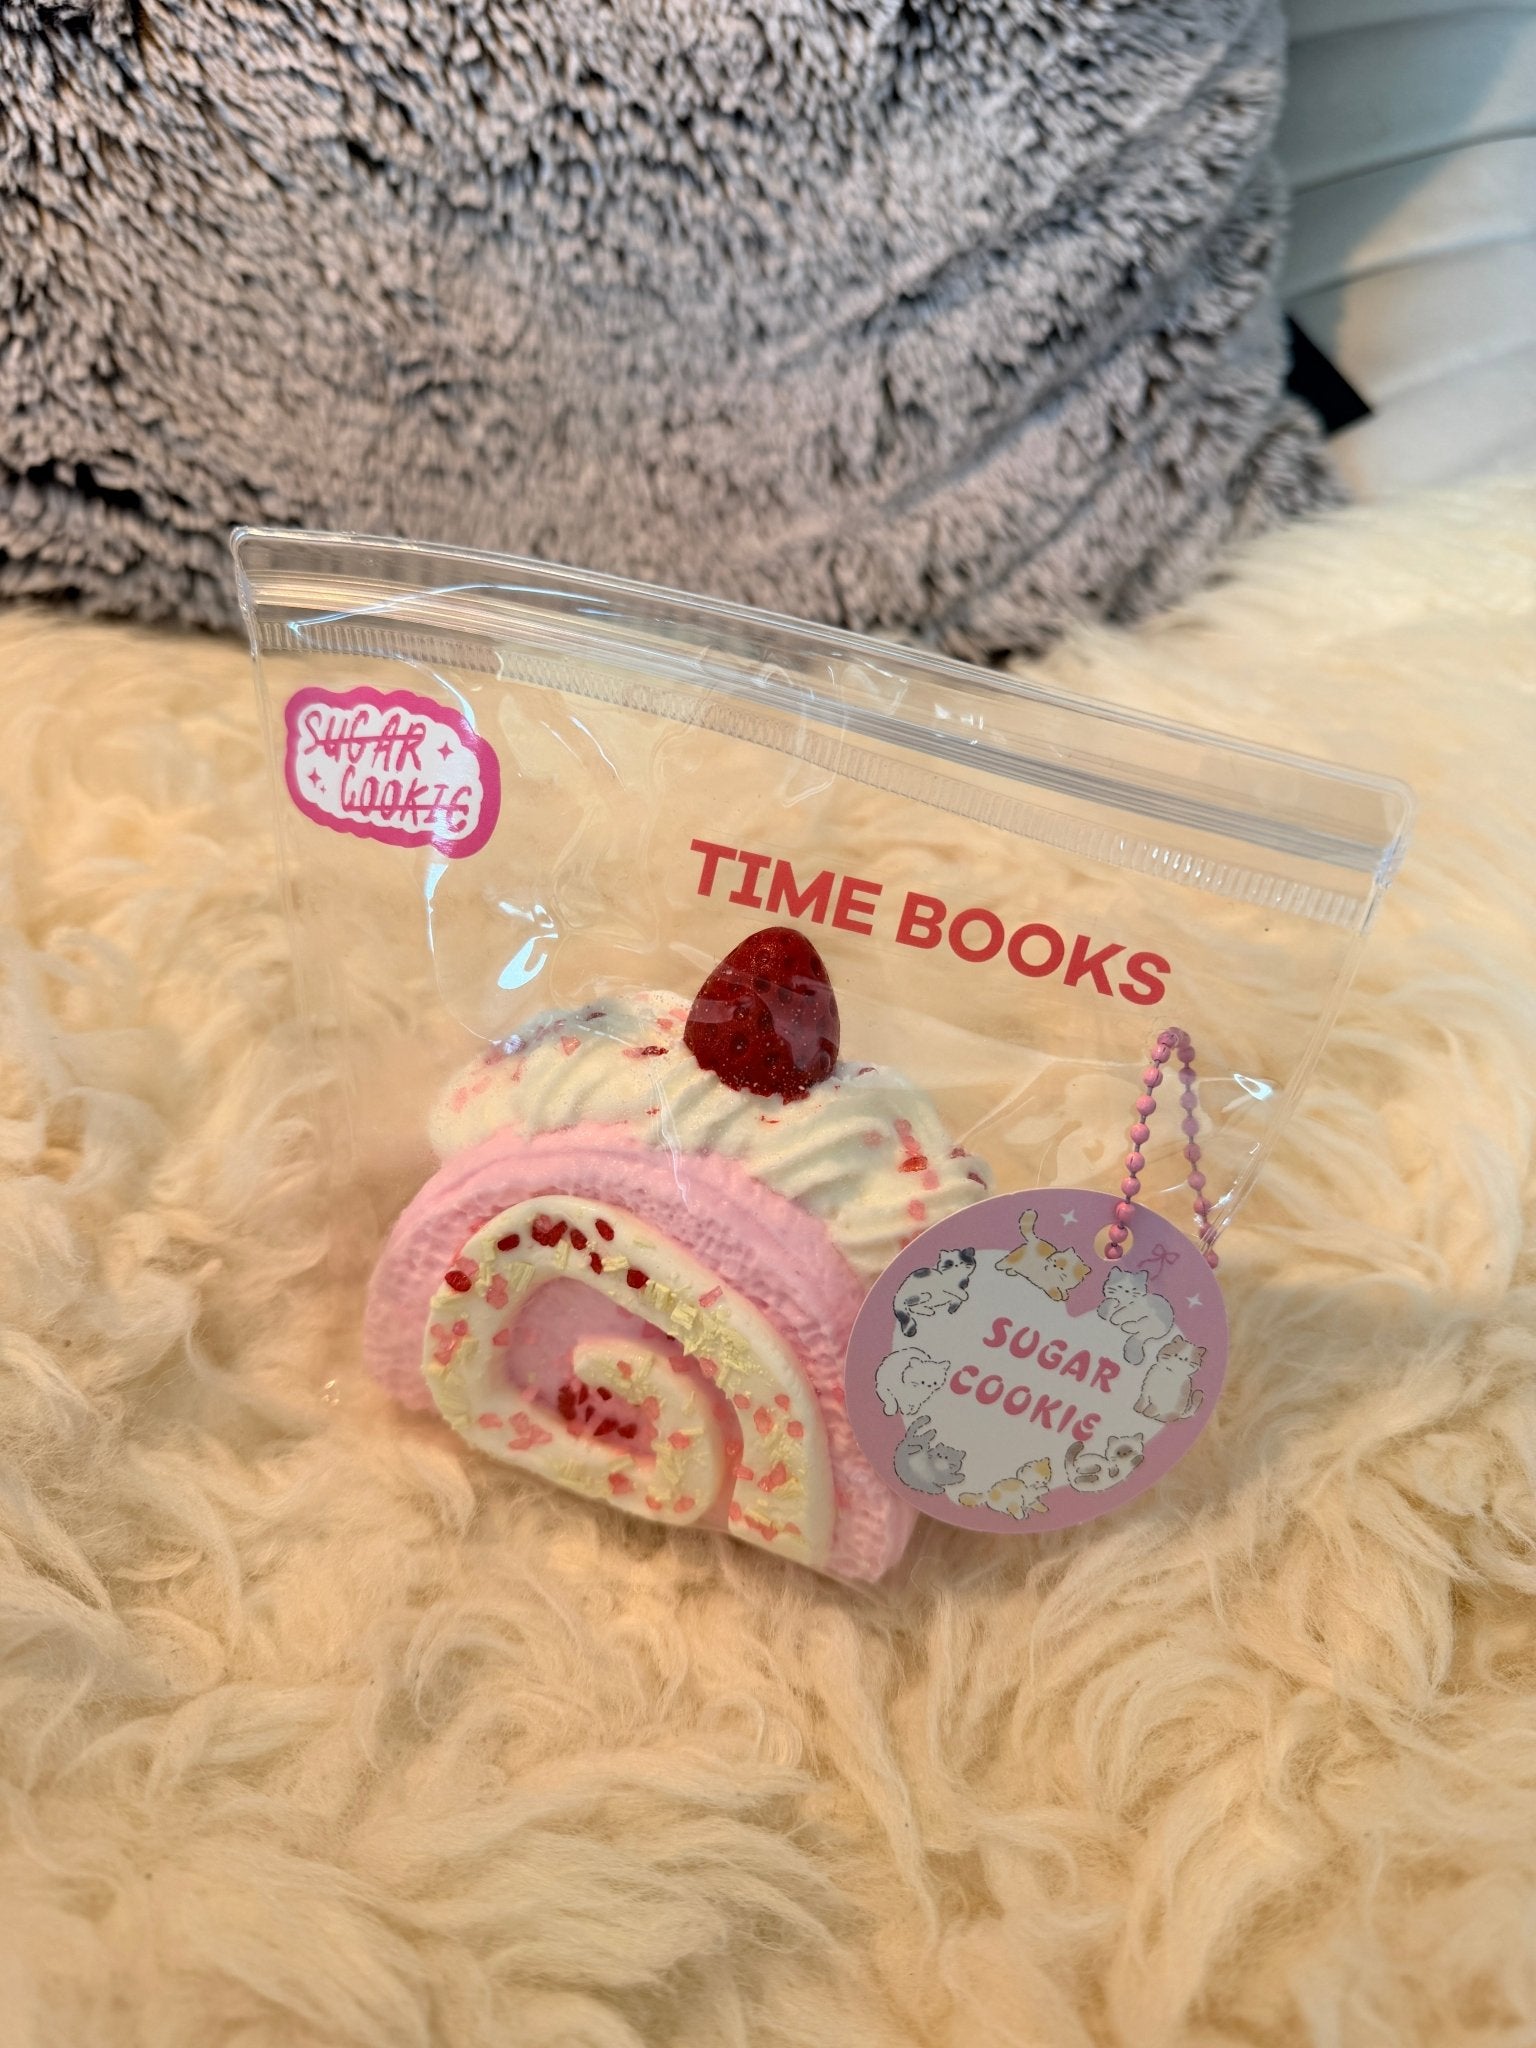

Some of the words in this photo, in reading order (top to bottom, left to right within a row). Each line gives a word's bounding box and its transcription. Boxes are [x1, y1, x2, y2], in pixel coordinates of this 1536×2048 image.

[304, 710, 427, 772] SUGAR
[690, 838, 883, 936] TIME
[895, 891, 1172, 1006] BOOKS
[982, 1316, 1121, 1393] SUGAR
[950, 1365, 1101, 1441] COOKIE
